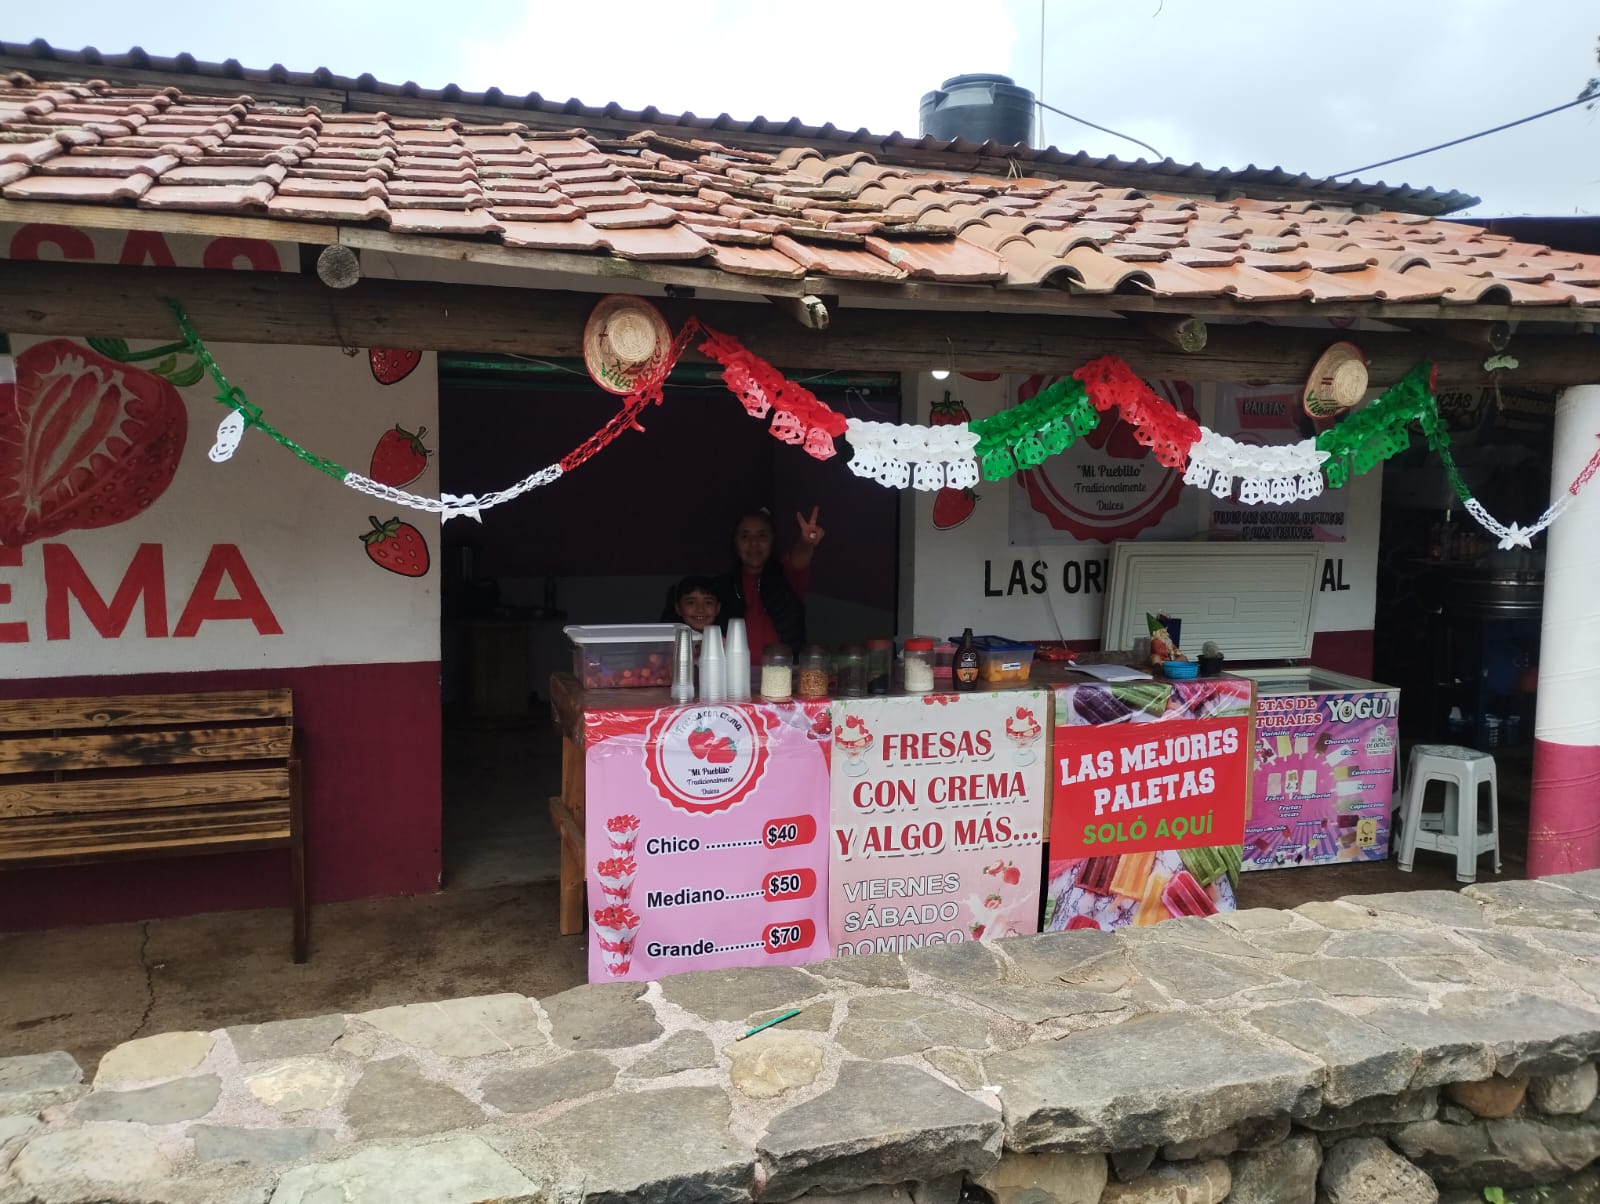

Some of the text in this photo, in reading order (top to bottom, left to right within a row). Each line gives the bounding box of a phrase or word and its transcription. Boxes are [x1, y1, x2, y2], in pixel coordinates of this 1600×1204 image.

[1074, 483, 1147, 494] Tradicionalmente
[1096, 500, 1124, 511] Dulces
[984, 560, 1048, 598] LAS
[1320, 558, 1350, 592] AL
[1297, 698, 1317, 710] DE
[1256, 713, 1323, 728] TURALES
[882, 730, 992, 761] FRESAS
[1060, 728, 1239, 786] LAS MEJORES
[853, 771, 1026, 808] CON CREMA
[1094, 767, 1215, 816] PALETAS
[646, 836, 700, 855] Chico
[768, 826, 796, 843] $40
[836, 811, 1038, 856] Y ALGO MÁS...
[1082, 810, 1213, 845] SOLÓ AQUÍ
[770, 875, 799, 893] $50
[843, 873, 961, 902] VIERNES
[844, 902, 959, 932] SÁBADO
[770, 927, 800, 945] $70
